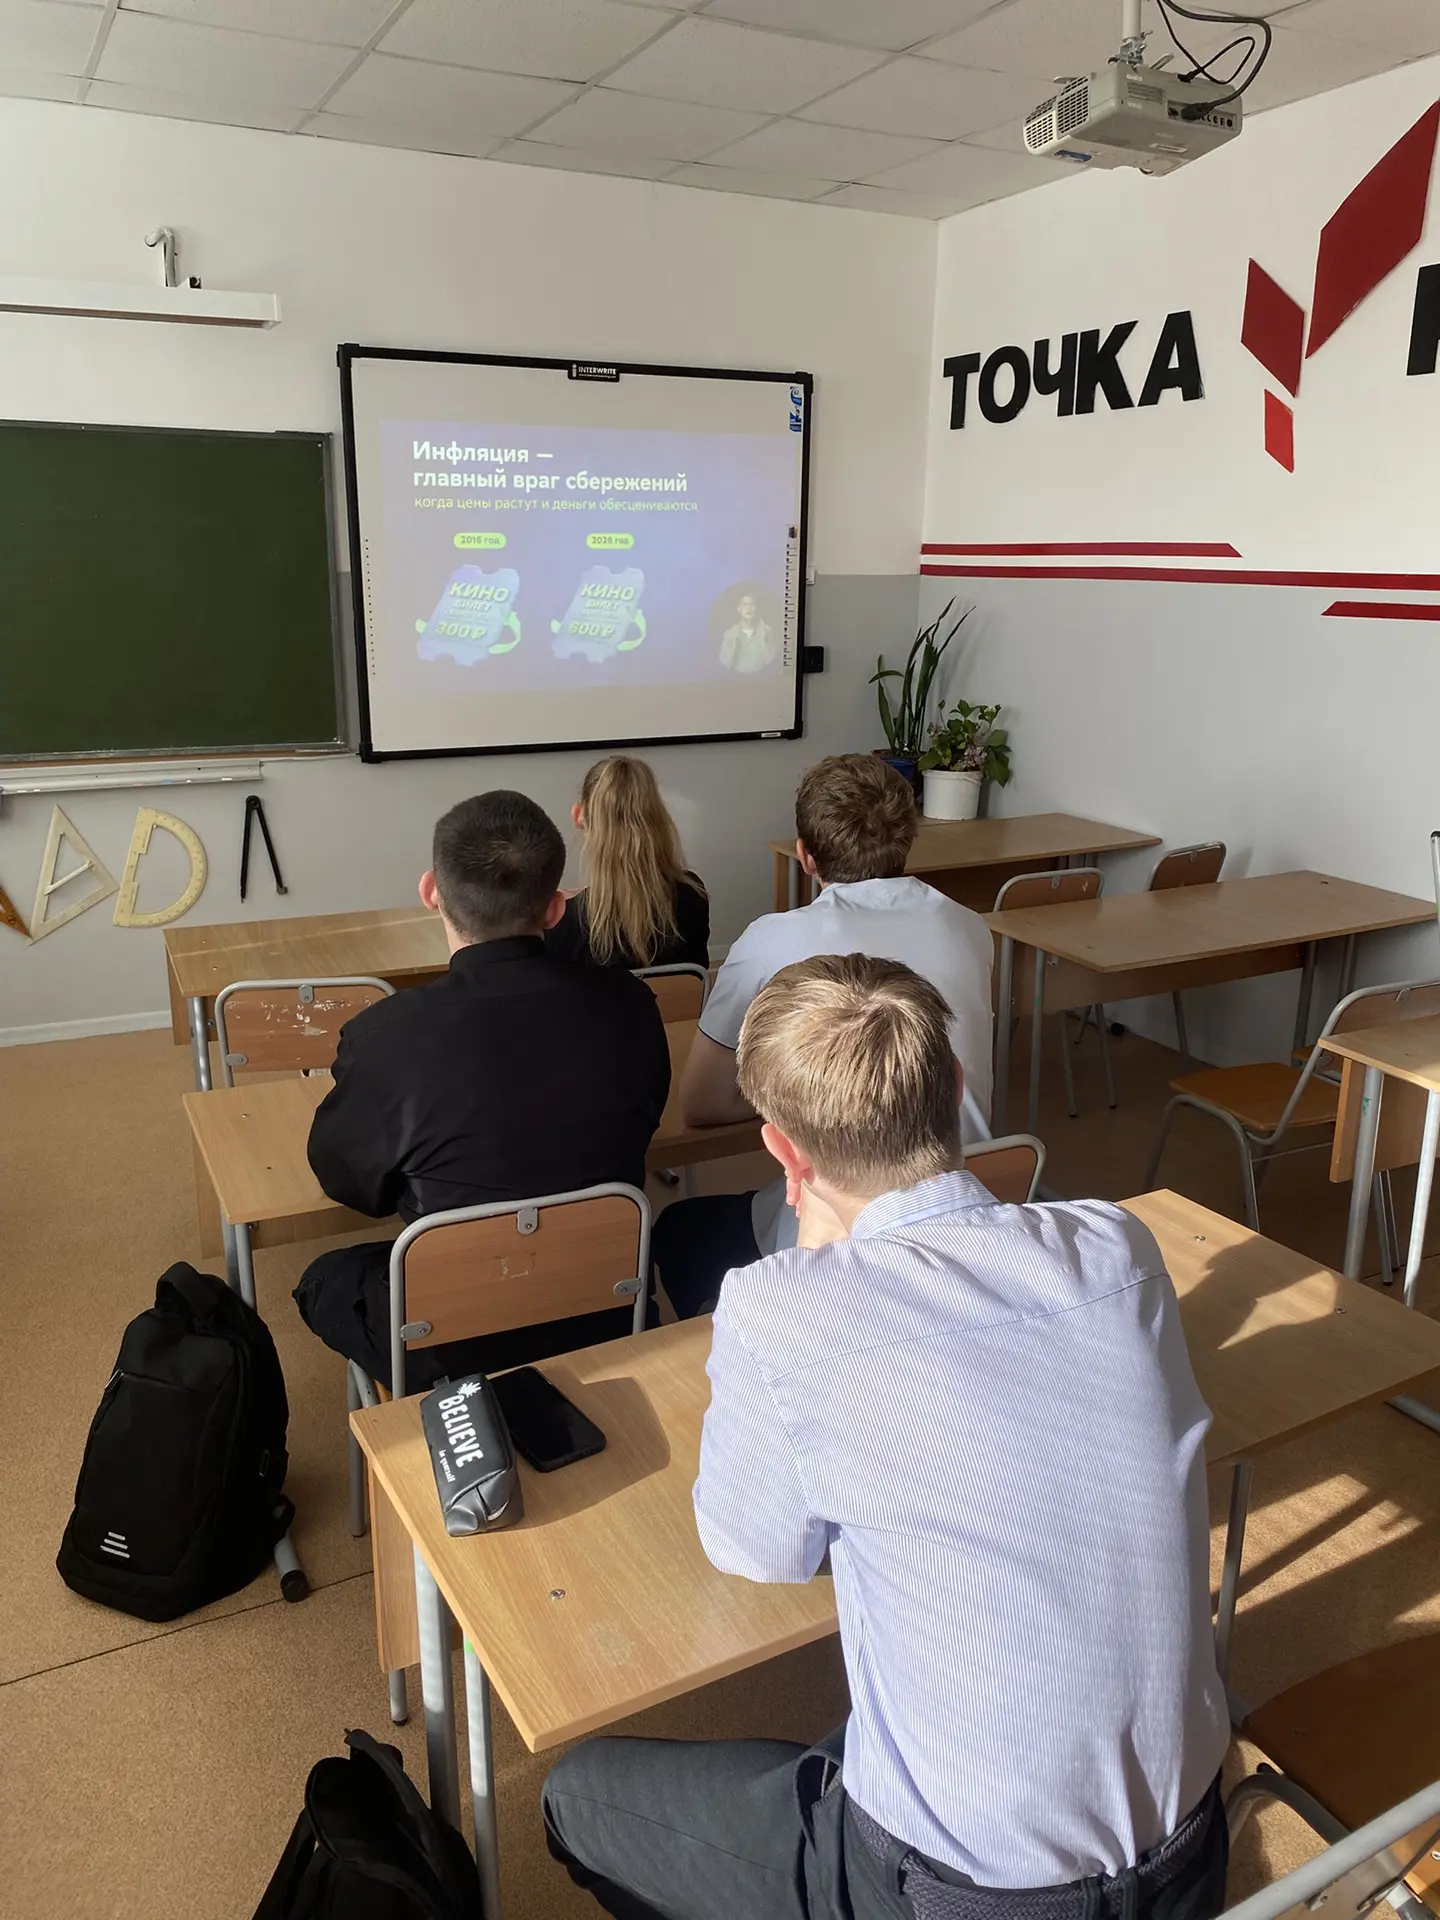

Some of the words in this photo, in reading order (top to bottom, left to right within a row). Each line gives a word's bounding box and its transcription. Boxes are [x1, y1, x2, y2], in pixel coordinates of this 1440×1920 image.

[578, 366, 616, 375] INTERWRITE
[943, 310, 1204, 430] ТОЧКА
[413, 441, 529, 465] Инфляция
[413, 468, 507, 488] главный
[513, 474, 560, 493] враг
[565, 470, 688, 494] сбережений
[414, 498, 453, 509] когда
[457, 499, 491, 509] цены
[495, 499, 537, 511] растут
[541, 500, 550, 508] и
[552, 499, 596, 511] деньги
[600, 498, 698, 512] обесцениваются
[484, 537, 501, 546] год
[614, 537, 630, 546] год
[448, 582, 509, 602] КИНО
[580, 583, 635, 601] КИНО
[438, 1394, 484, 1468] BELIEVE
